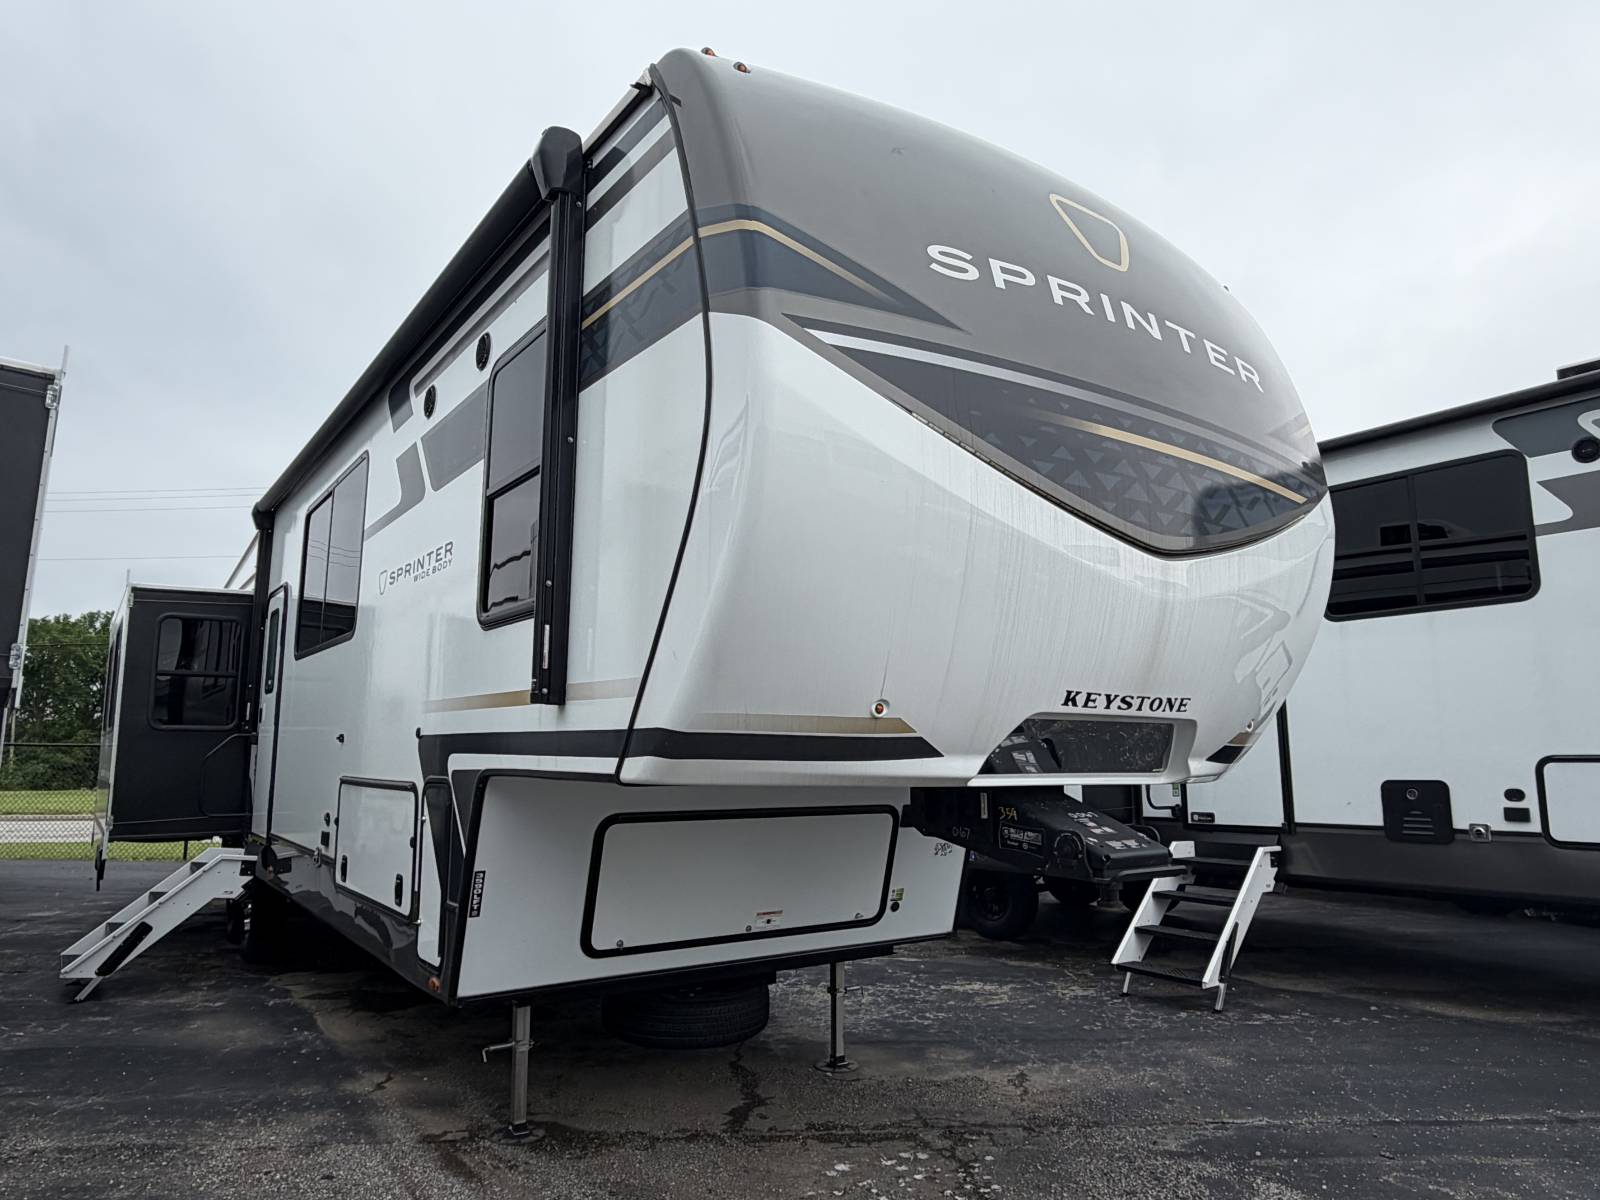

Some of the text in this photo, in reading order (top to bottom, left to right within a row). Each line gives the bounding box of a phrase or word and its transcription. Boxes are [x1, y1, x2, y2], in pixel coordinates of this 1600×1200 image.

[926, 244, 1264, 392] SPRINTER
[388, 541, 454, 586] SPRINTER
[413, 558, 453, 583] WIDE BODY
[1061, 689, 1192, 713] KEYSTONE
